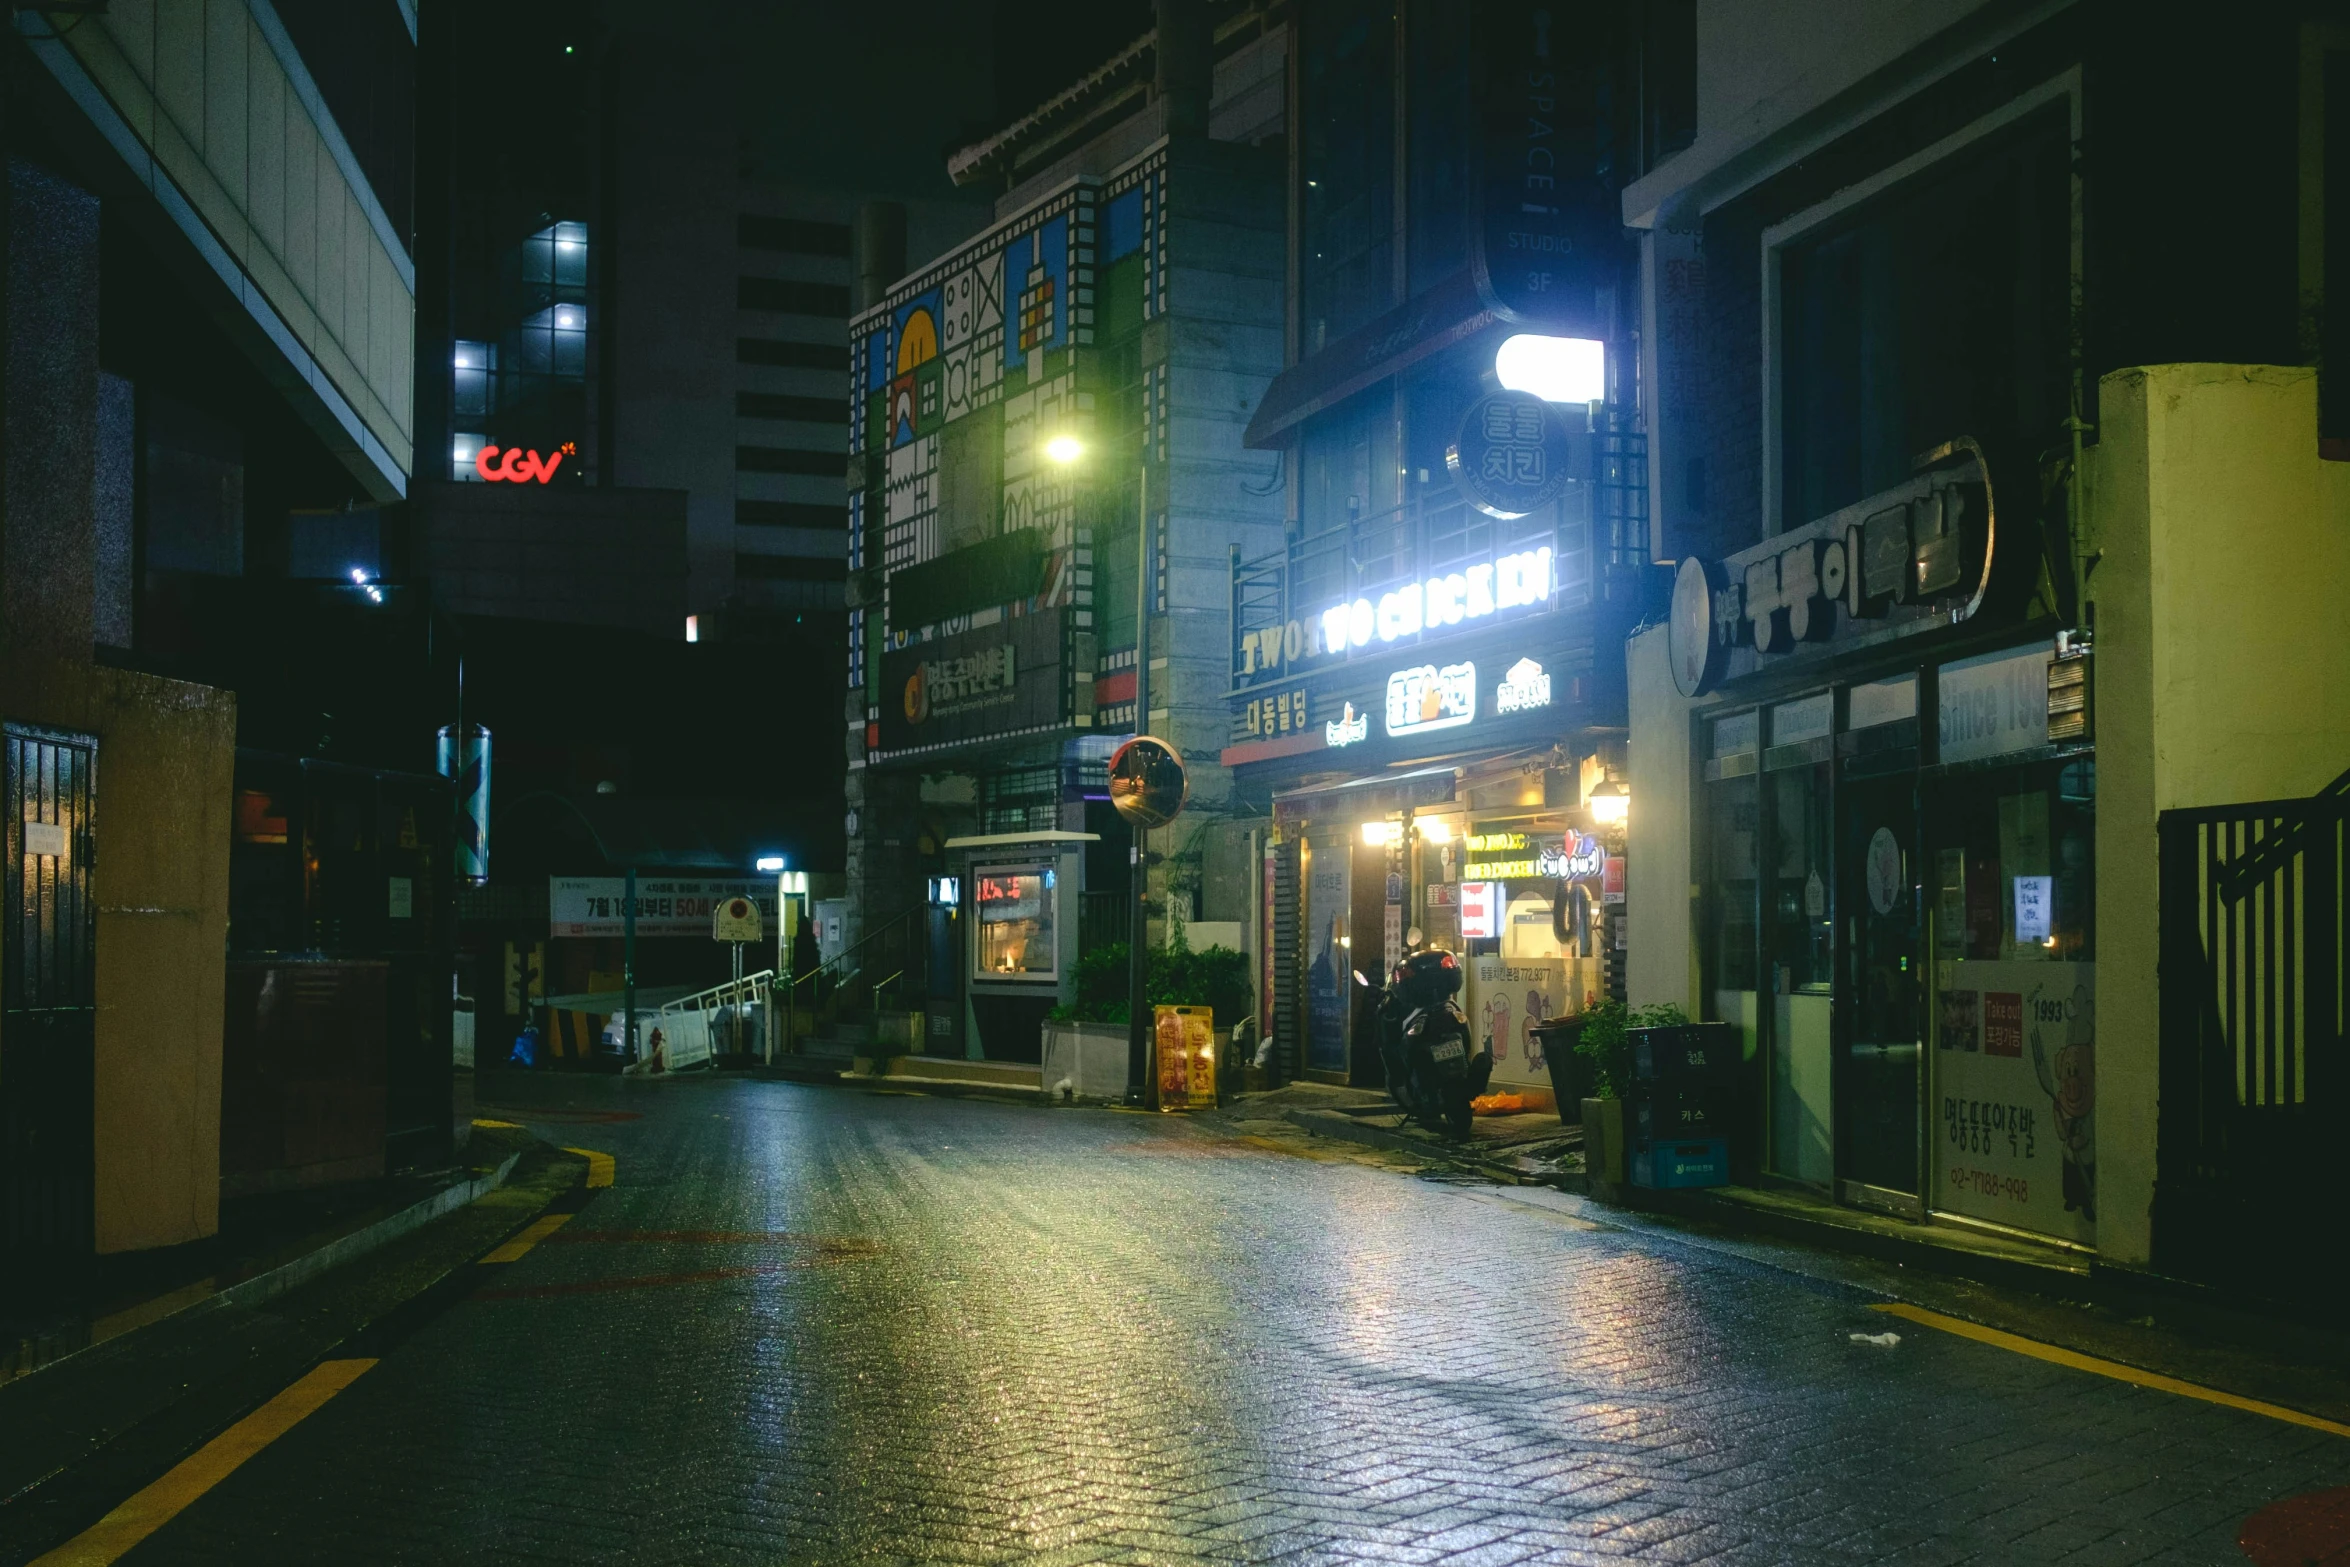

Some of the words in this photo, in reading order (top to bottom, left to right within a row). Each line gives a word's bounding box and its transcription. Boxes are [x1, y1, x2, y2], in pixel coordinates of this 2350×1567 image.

[1527, 72, 1555, 190] SPACE
[1508, 231, 1573, 254] STUDIO
[1526, 271, 1553, 293] 3F
[1486, 404, 1541, 440] 둘둘
[475, 444, 563, 485] CGV
[1486, 449, 1542, 481] 치킨
[1376, 546, 1552, 642] CHICKEN
[1246, 688, 1307, 737] 대동빌딩
[586, 898, 610, 917] 7월
[675, 898, 709, 917] 50세
[1986, 1000, 2006, 1019] Take
[2007, 1003, 2021, 1020] out
[2033, 999, 2063, 1022] 1993
[1950, 1167, 2029, 1203] 02-7788-998
